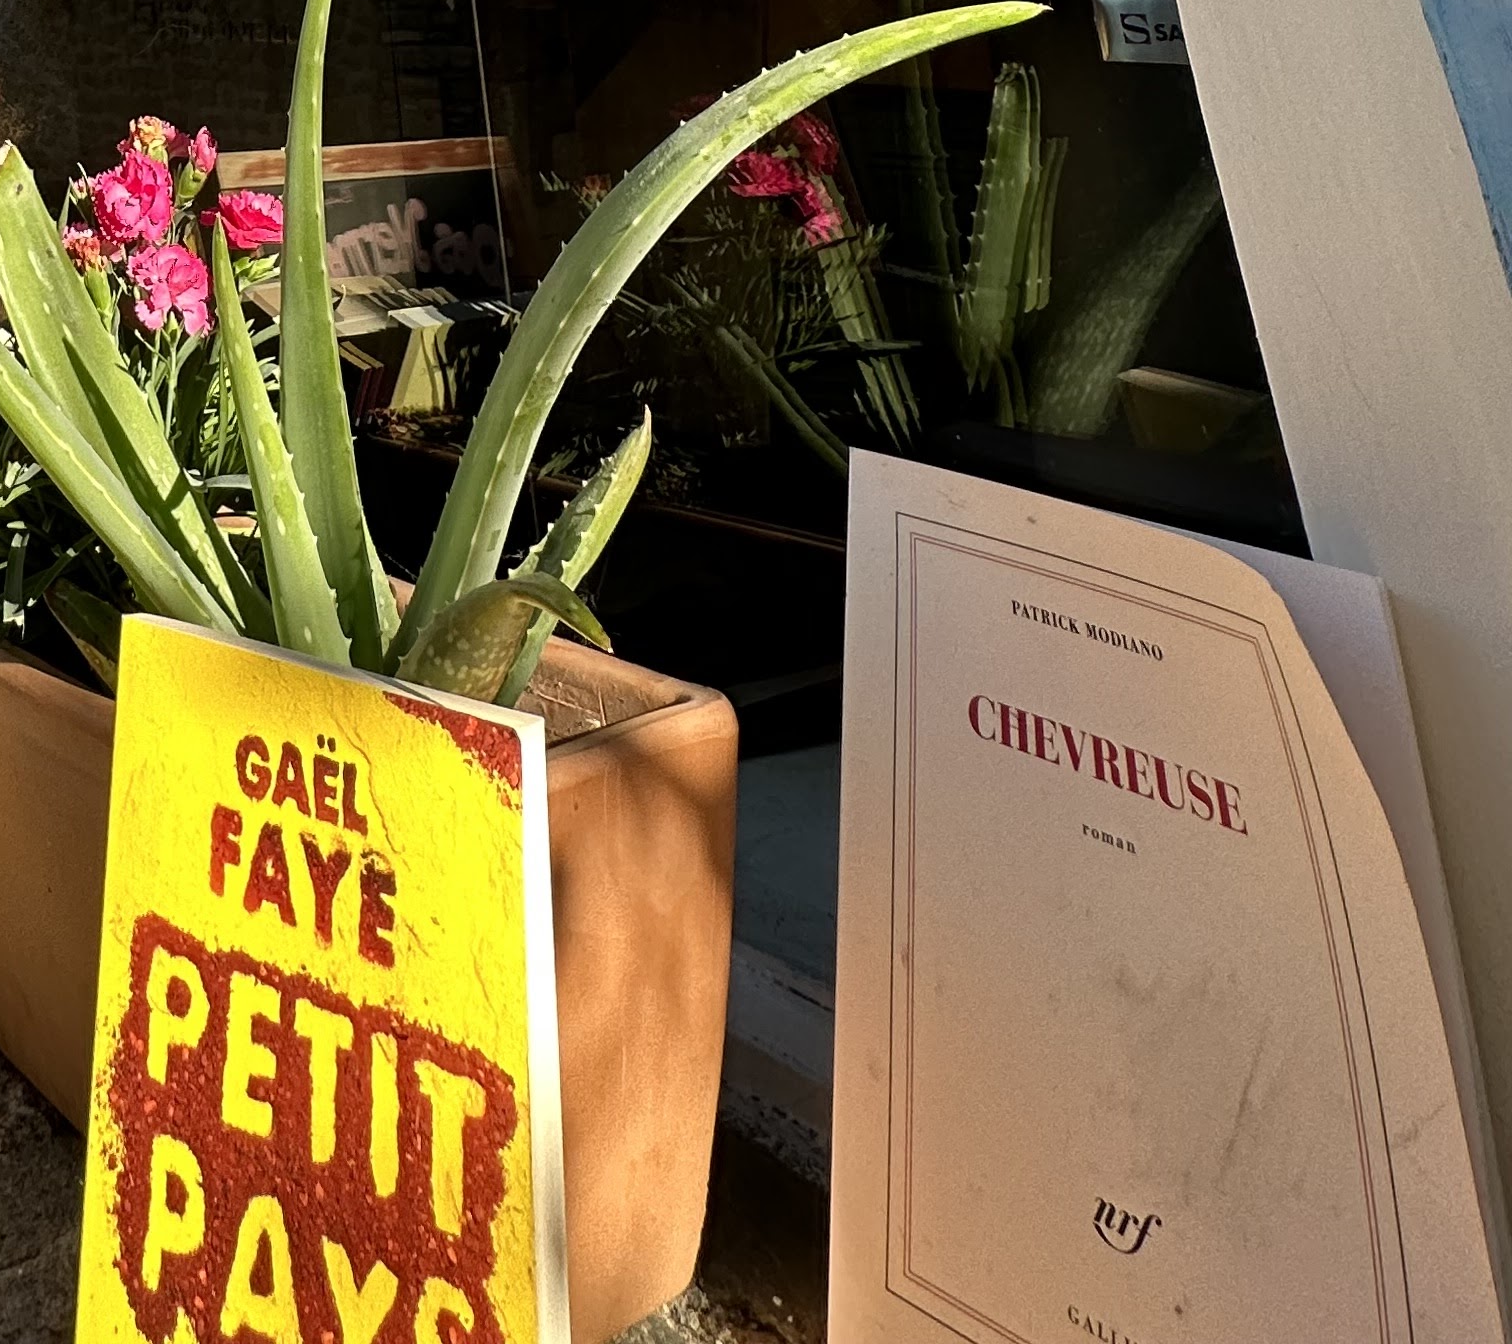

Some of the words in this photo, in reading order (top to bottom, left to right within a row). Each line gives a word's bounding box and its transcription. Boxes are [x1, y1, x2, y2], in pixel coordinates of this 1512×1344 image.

[1011, 599, 1080, 635] PATRICK
[1086, 621, 1164, 662] MODIANO
[235, 733, 369, 836] GAËL
[967, 694, 1249, 837] CHEVREUSE
[208, 803, 399, 969] FAYE
[1081, 822, 1137, 855] roman
[145, 945, 487, 1238] PETIT
[1092, 1196, 1163, 1255] nrf
